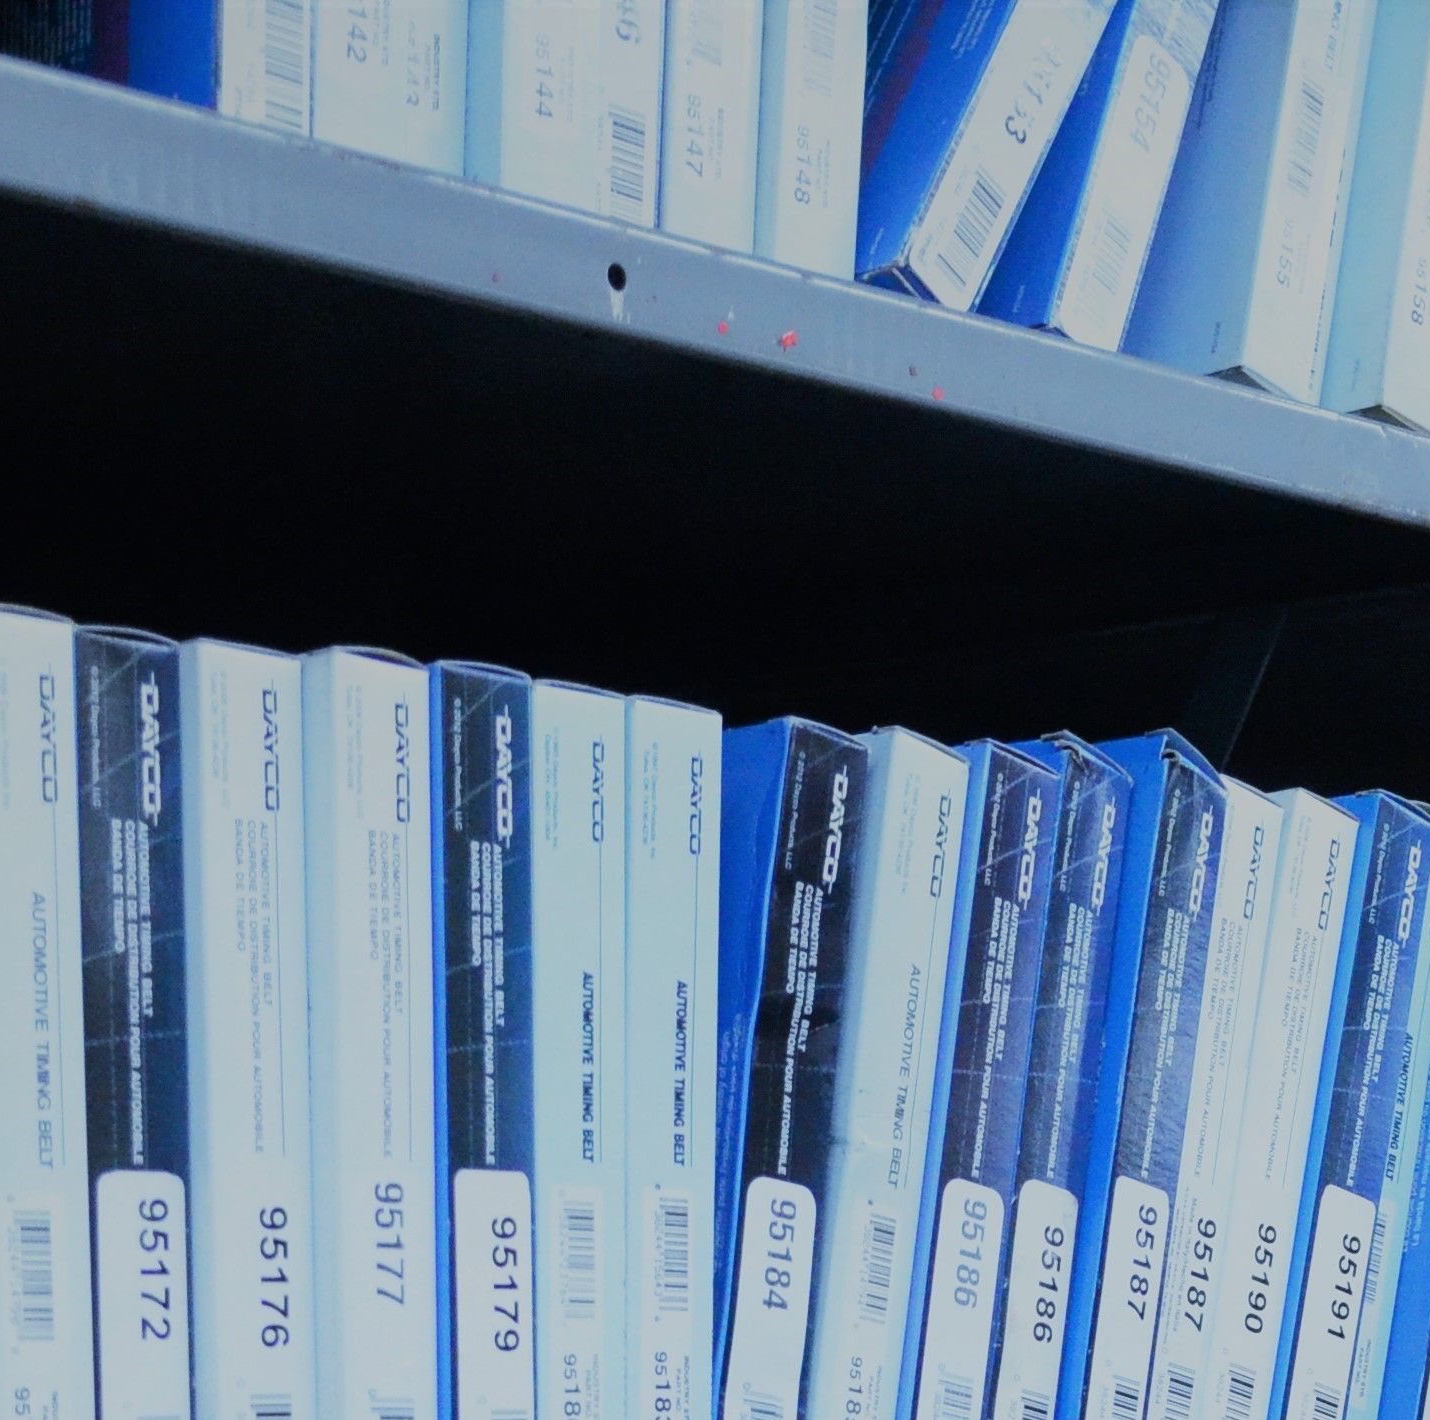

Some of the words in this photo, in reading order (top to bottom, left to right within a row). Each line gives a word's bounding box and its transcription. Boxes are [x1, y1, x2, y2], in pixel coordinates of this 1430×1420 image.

[534, 32, 555, 120] 95144
[1128, 52, 1173, 153] 95154
[684, 95, 705, 178] 95147
[793, 126, 812, 206] 95148
[1410, 256, 1430, 327] 95158
[37, 674, 58, 804] DAYCO
[139, 682, 162, 815] DAYCO
[260, 688, 281, 814] DAYCO
[393, 701, 411, 824] DAYCO
[495, 715, 513, 836] DAYCO
[822, 772, 849, 884] DAYCO
[929, 794, 952, 899] DAYCO
[1017, 796, 1042, 902] DAYCO
[1091, 802, 1116, 908] DAYCO
[1188, 812, 1213, 914] DAYCO
[1242, 825, 1266, 921] DAYCO
[1317, 837, 1342, 932] DAYCO
[1397, 845, 1422, 941] DAYCO
[31, 891, 50, 1031] AUTOMOTIVE
[675, 980, 689, 1071] AUTOMOTIVE
[899, 964, 923, 1077] AUTOMOTIVE
[36, 1041, 53, 1110] TIMING
[674, 1078, 687, 1127] TIMING
[892, 1085, 910, 1140] TIMING
[37, 1119, 55, 1170] BELT
[674, 1134, 687, 1167] BELT
[887, 1147, 904, 1189] BELT
[136, 1198, 172, 1342] 95172
[257, 1206, 291, 1350] 95176
[373, 1181, 406, 1306] 95177
[491, 1215, 520, 1352] 95179
[761, 1197, 798, 1311] 95184
[952, 1199, 988, 1309] 95186
[1032, 1226, 1064, 1343] 95186
[1126, 1204, 1158, 1320] 95187
[1183, 1217, 1217, 1332] 95187
[1242, 1222, 1278, 1334] 95190
[1326, 1233, 1362, 1340] 95191
